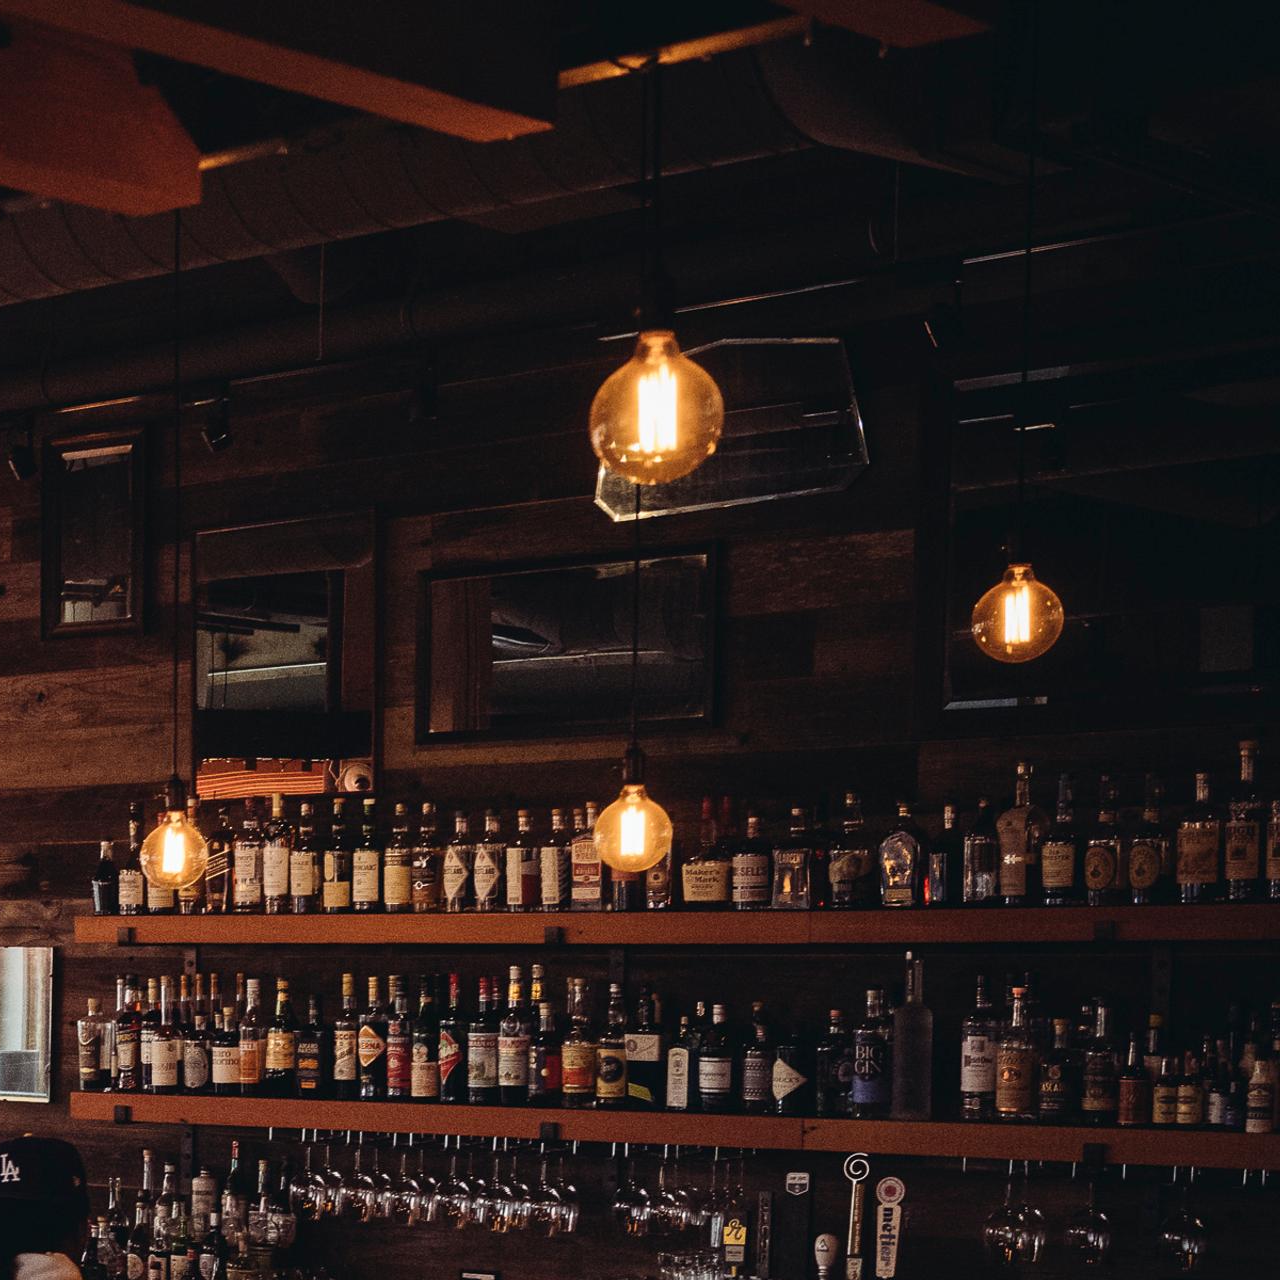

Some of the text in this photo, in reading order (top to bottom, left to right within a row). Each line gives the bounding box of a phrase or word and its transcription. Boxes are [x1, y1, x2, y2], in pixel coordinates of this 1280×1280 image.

[685, 868, 720, 876] Maker's
[855, 1045, 883, 1060] BIG
[854, 1060, 882, 1075] GIN
[0, 1153, 21, 1183] LA
